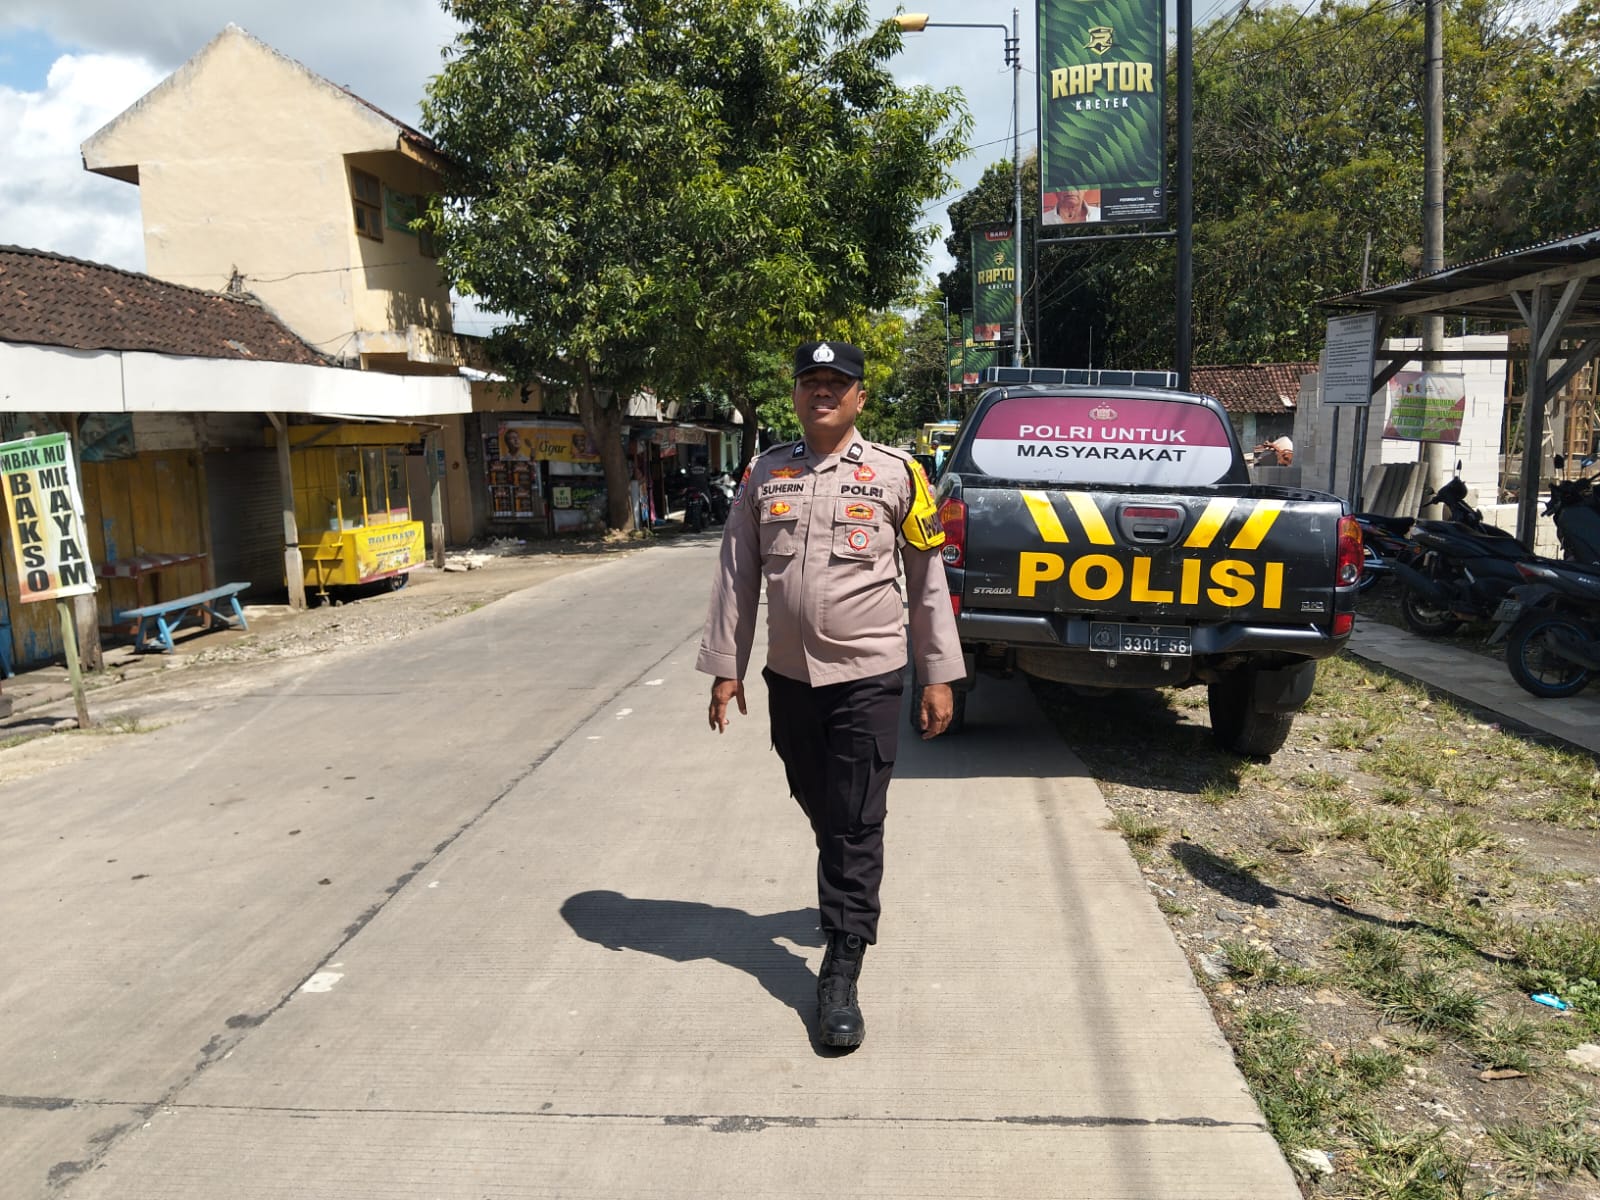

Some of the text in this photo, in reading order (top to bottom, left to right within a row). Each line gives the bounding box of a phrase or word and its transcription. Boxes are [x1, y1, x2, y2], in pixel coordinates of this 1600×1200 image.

[1050, 61, 1154, 99] RAPTOR
[1075, 97, 1129, 111] KRETEK
[977, 267, 1015, 285] RAPTO
[1019, 425, 1187, 443] POLRI UNTUK
[1017, 444, 1187, 462] MASYARAKAT
[762, 483, 805, 496] SUHERIN
[840, 484, 884, 499] POLRI
[9, 472, 50, 593] BAKSO
[50, 489, 88, 587] AYAM
[1017, 551, 1284, 609] POLISI
[972, 586, 1012, 595] STRADA
[1123, 636, 1187, 653] 3301-56
